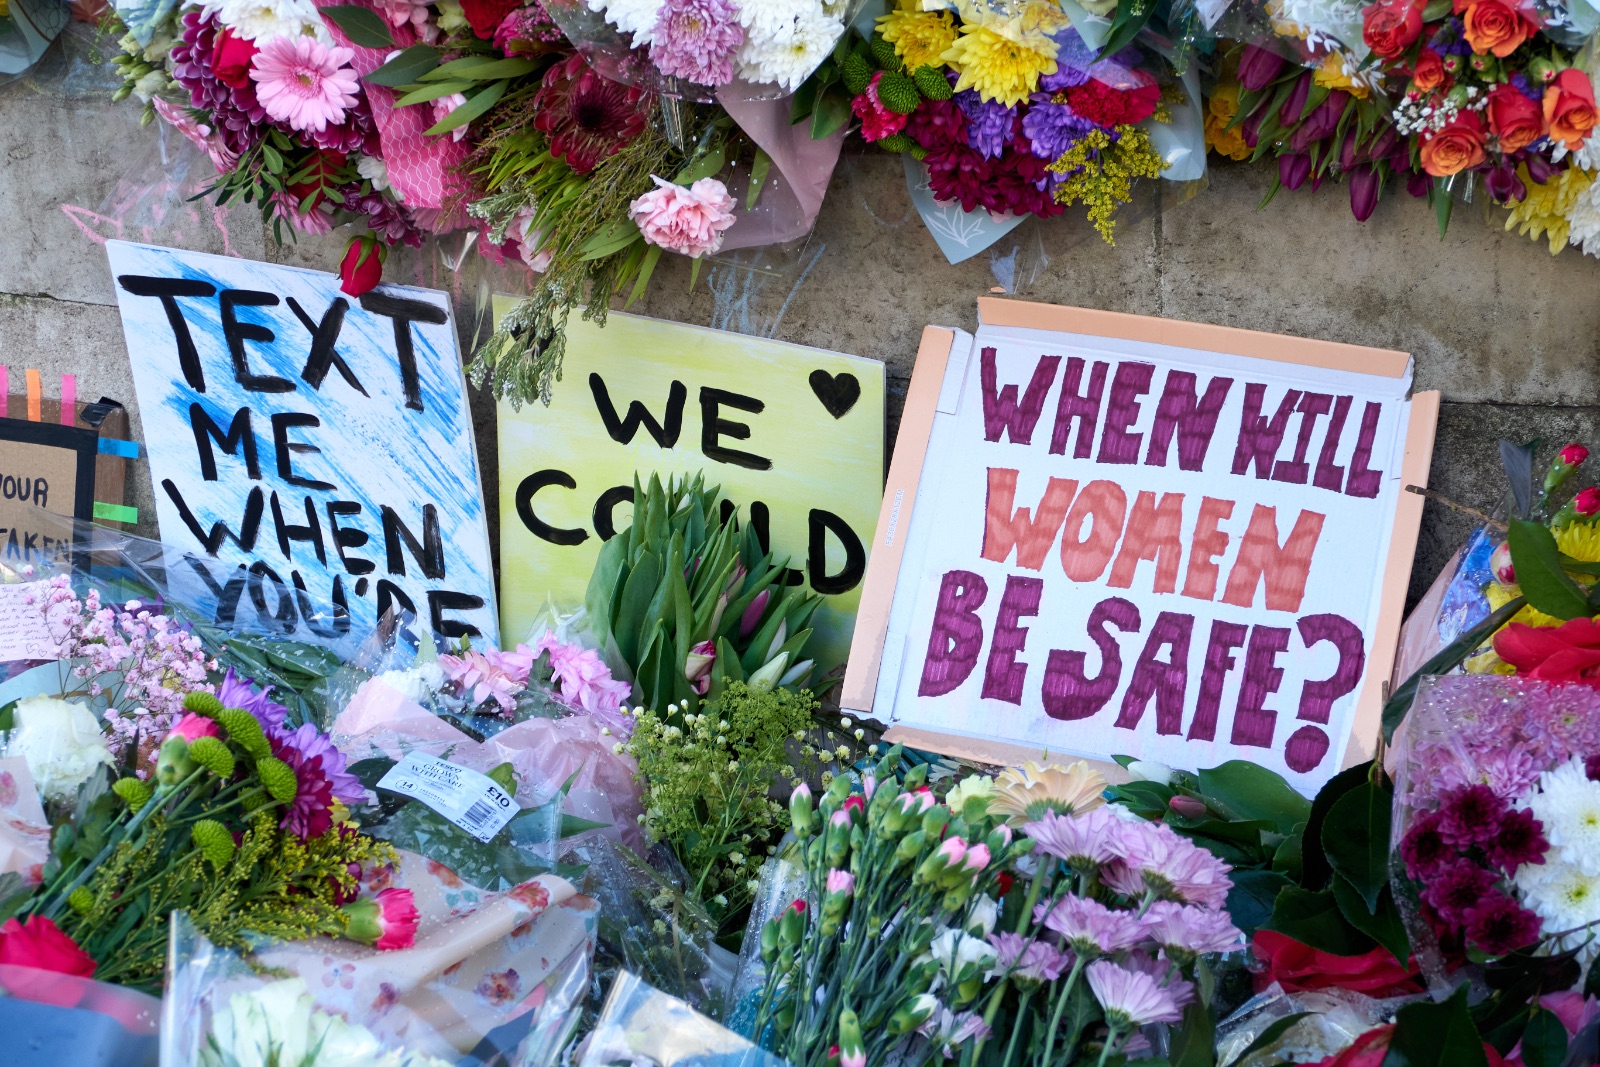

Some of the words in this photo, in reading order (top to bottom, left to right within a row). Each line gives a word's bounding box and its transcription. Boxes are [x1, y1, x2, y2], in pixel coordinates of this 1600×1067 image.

[118, 274, 448, 413] TEXT
[189, 402, 337, 490] ME
[589, 372, 773, 471] WE
[979, 346, 1234, 472] WHEN
[1230, 382, 1383, 500] WILL
[0, 527, 71, 562] AKEN
[161, 478, 446, 580] WHEN
[980, 467, 1326, 613] WOMEN
[918, 569, 1044, 706] BE
[1041, 596, 1366, 775] SAFE?
[402, 781, 414, 789] 14
[412, 765, 437, 779] WITH
[423, 763, 461, 780] GROWN
[486, 786, 510, 808] £10
